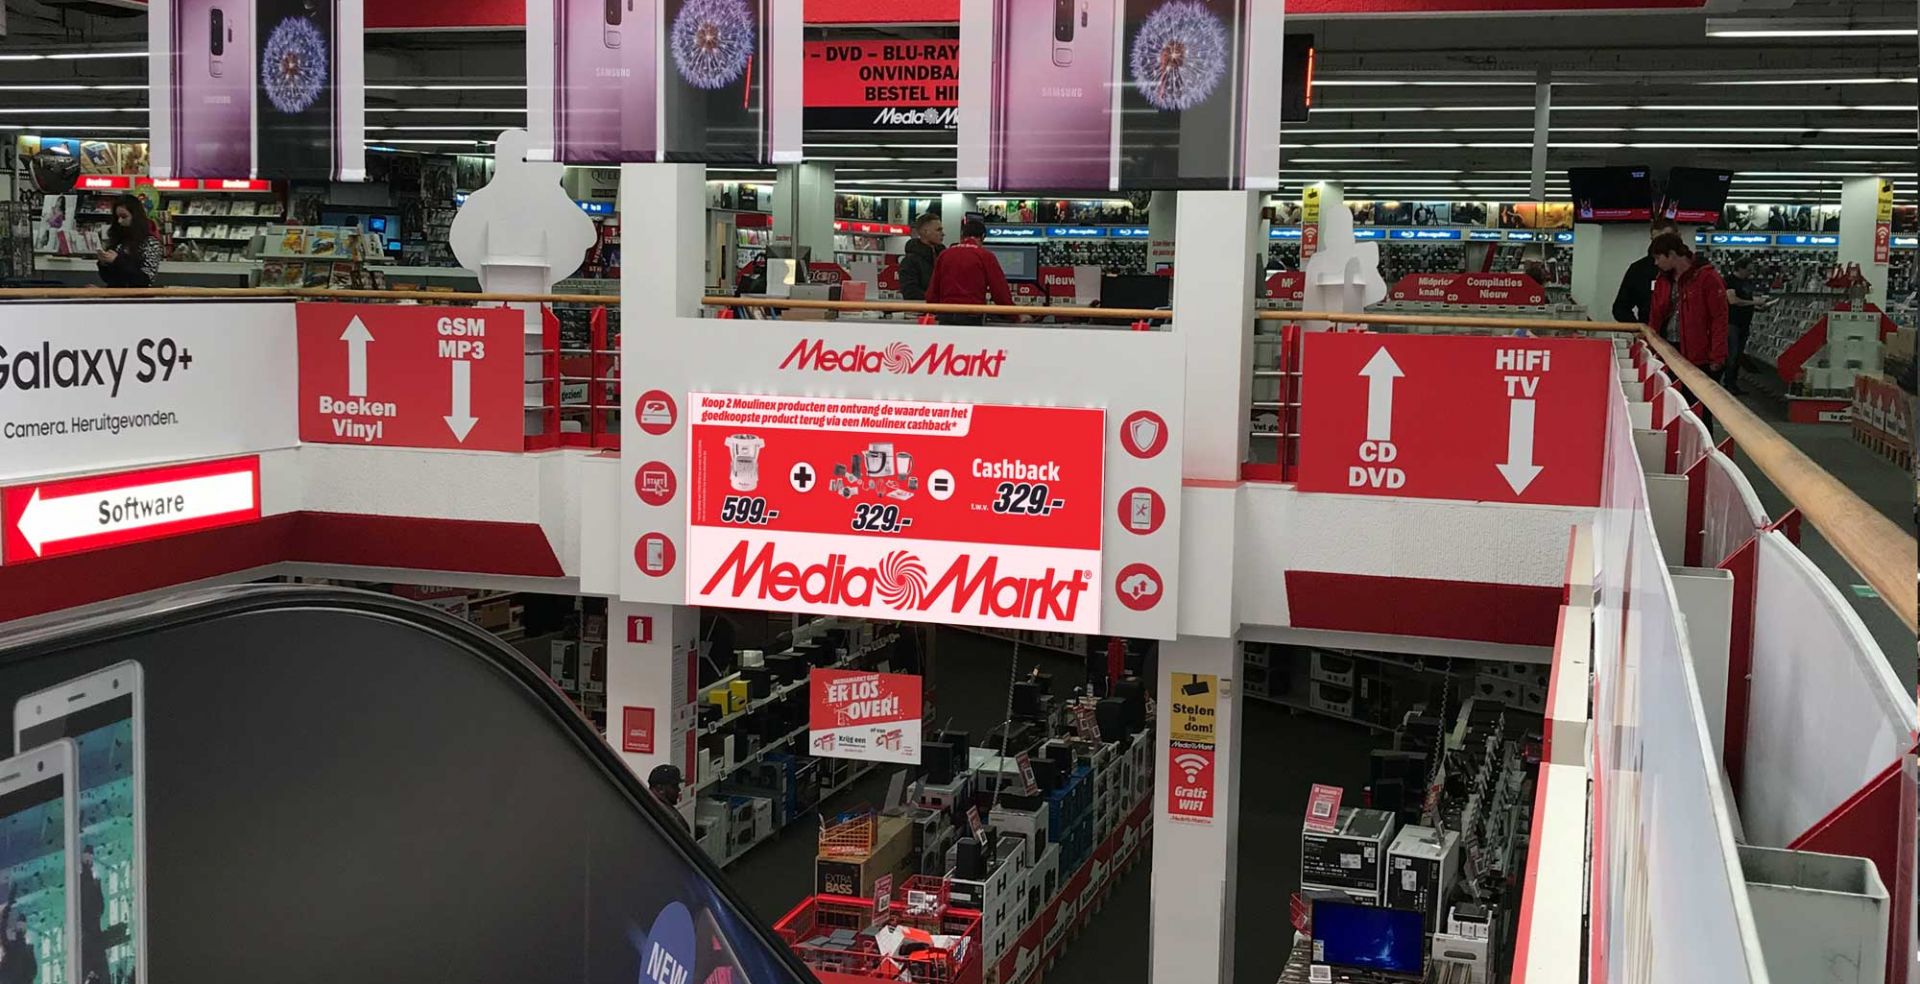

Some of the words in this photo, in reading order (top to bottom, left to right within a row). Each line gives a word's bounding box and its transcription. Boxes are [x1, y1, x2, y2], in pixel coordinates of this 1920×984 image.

[826, 46, 862, 61] DVD
[883, 45, 959, 60] BLU-RAY
[859, 65, 959, 80] ONVINDBA
[865, 86, 930, 101] BESTEL
[873, 108, 925, 124] Media
[1467, 277, 1523, 289] Compilaties
[1480, 289, 1509, 299] Nieuw
[437, 317, 485, 336] GSM
[136, 337, 192, 383] S9+
[438, 340, 485, 359] MP3
[1496, 349, 1551, 371] HiFi
[1504, 376, 1540, 397] TV
[319, 396, 396, 417] Boeken
[702, 397, 725, 409] Koop
[726, 398, 732, 408] 2
[733, 399, 776, 410] Moulinex
[777, 401, 826, 412] producten
[827, 404, 839, 412] en
[840, 404, 880, 416] ontvang
[881, 405, 893, 415] de
[894, 406, 930, 416] waarde
[931, 408, 950, 418] van
[951, 407, 968, 418] het
[4, 421, 68, 438] Camera.
[72, 411, 178, 435] Heruitgevonden.
[332, 418, 383, 441] Vinyl
[701, 410, 760, 423] goedkoopste
[762, 413, 798, 424] product
[800, 415, 825, 427] terug
[826, 416, 840, 426] via
[842, 418, 860, 427] een
[860, 417, 906, 429] Moulinex
[1358, 441, 1397, 463] CD
[972, 458, 1060, 481] Cashback
[1348, 466, 1406, 489] DVD
[98, 494, 184, 525] Software
[993, 481, 1065, 517] 329.-
[721, 495, 779, 525] 599.-
[852, 503, 912, 533] 329.-
[852, 681, 879, 700] LOS
[848, 696, 899, 719] OVER!
[1173, 703, 1215, 716] Stelen
[1184, 723, 1213, 733] dom!
[1175, 786, 1208, 799] Gratis
[825, 882, 853, 895] BASS
